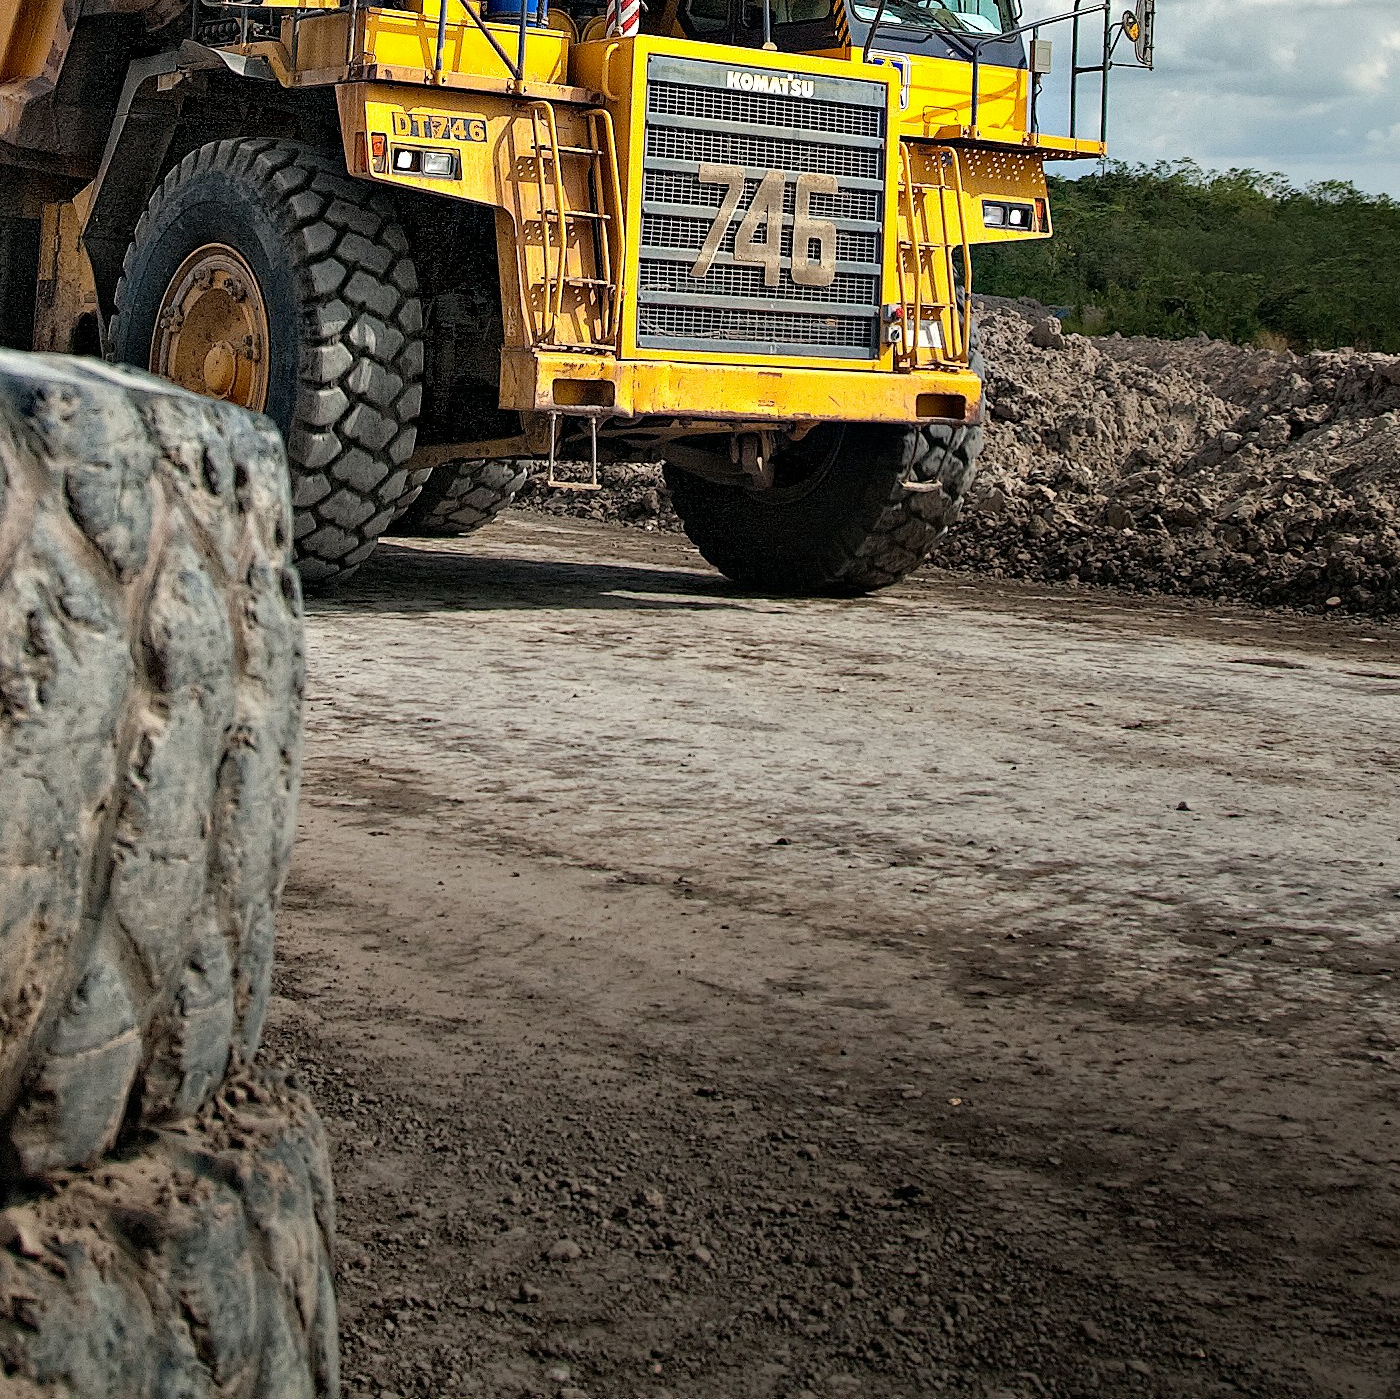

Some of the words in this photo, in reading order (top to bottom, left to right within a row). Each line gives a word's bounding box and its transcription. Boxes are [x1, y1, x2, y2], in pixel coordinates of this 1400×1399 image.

[726, 70, 814, 99] KOMATSU
[393, 112, 485, 141] DT746
[690, 163, 838, 287] 746
